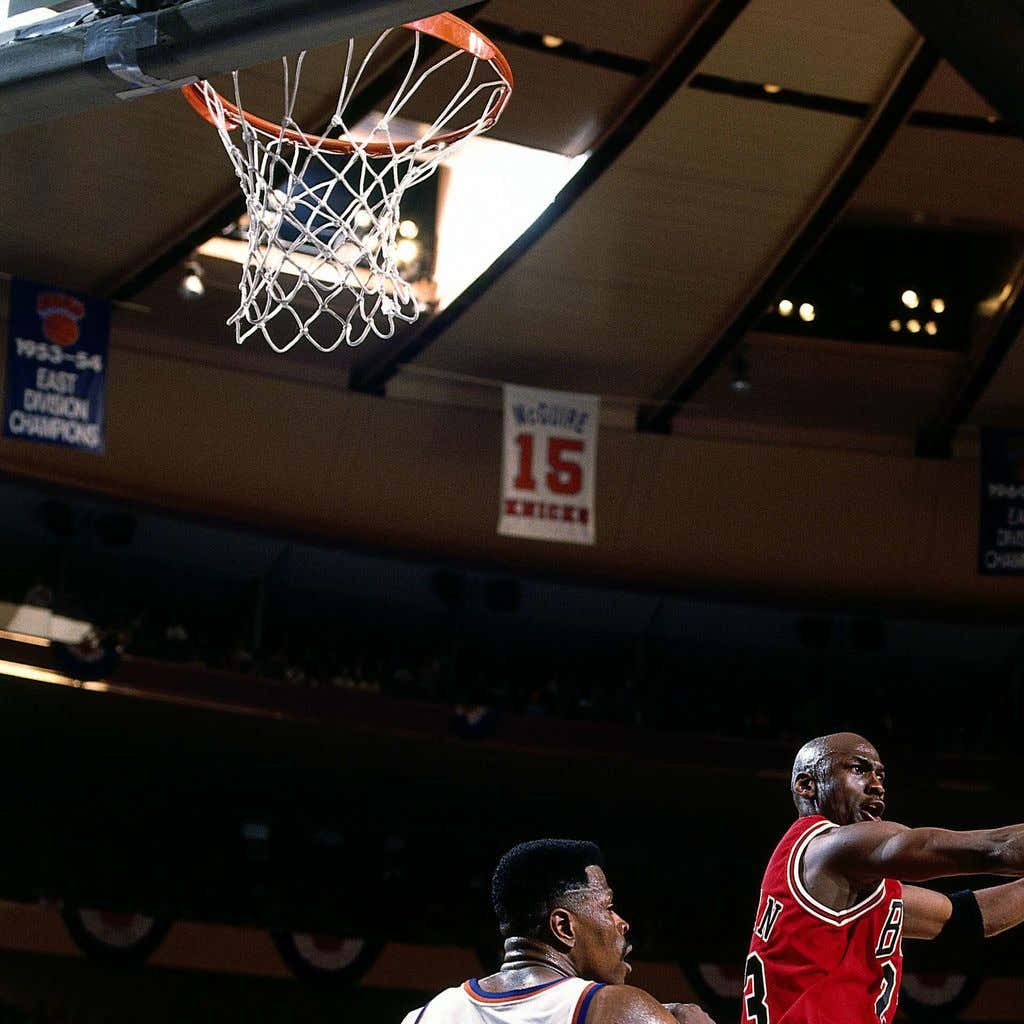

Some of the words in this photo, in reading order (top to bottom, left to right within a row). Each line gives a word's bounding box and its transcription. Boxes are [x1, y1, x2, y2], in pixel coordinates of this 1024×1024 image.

[36, 367, 78, 393] EAST
[24, 387, 90, 420] DIVISION
[8, 409, 101, 449] CHAMPIONS
[514, 433, 584, 495] 15
